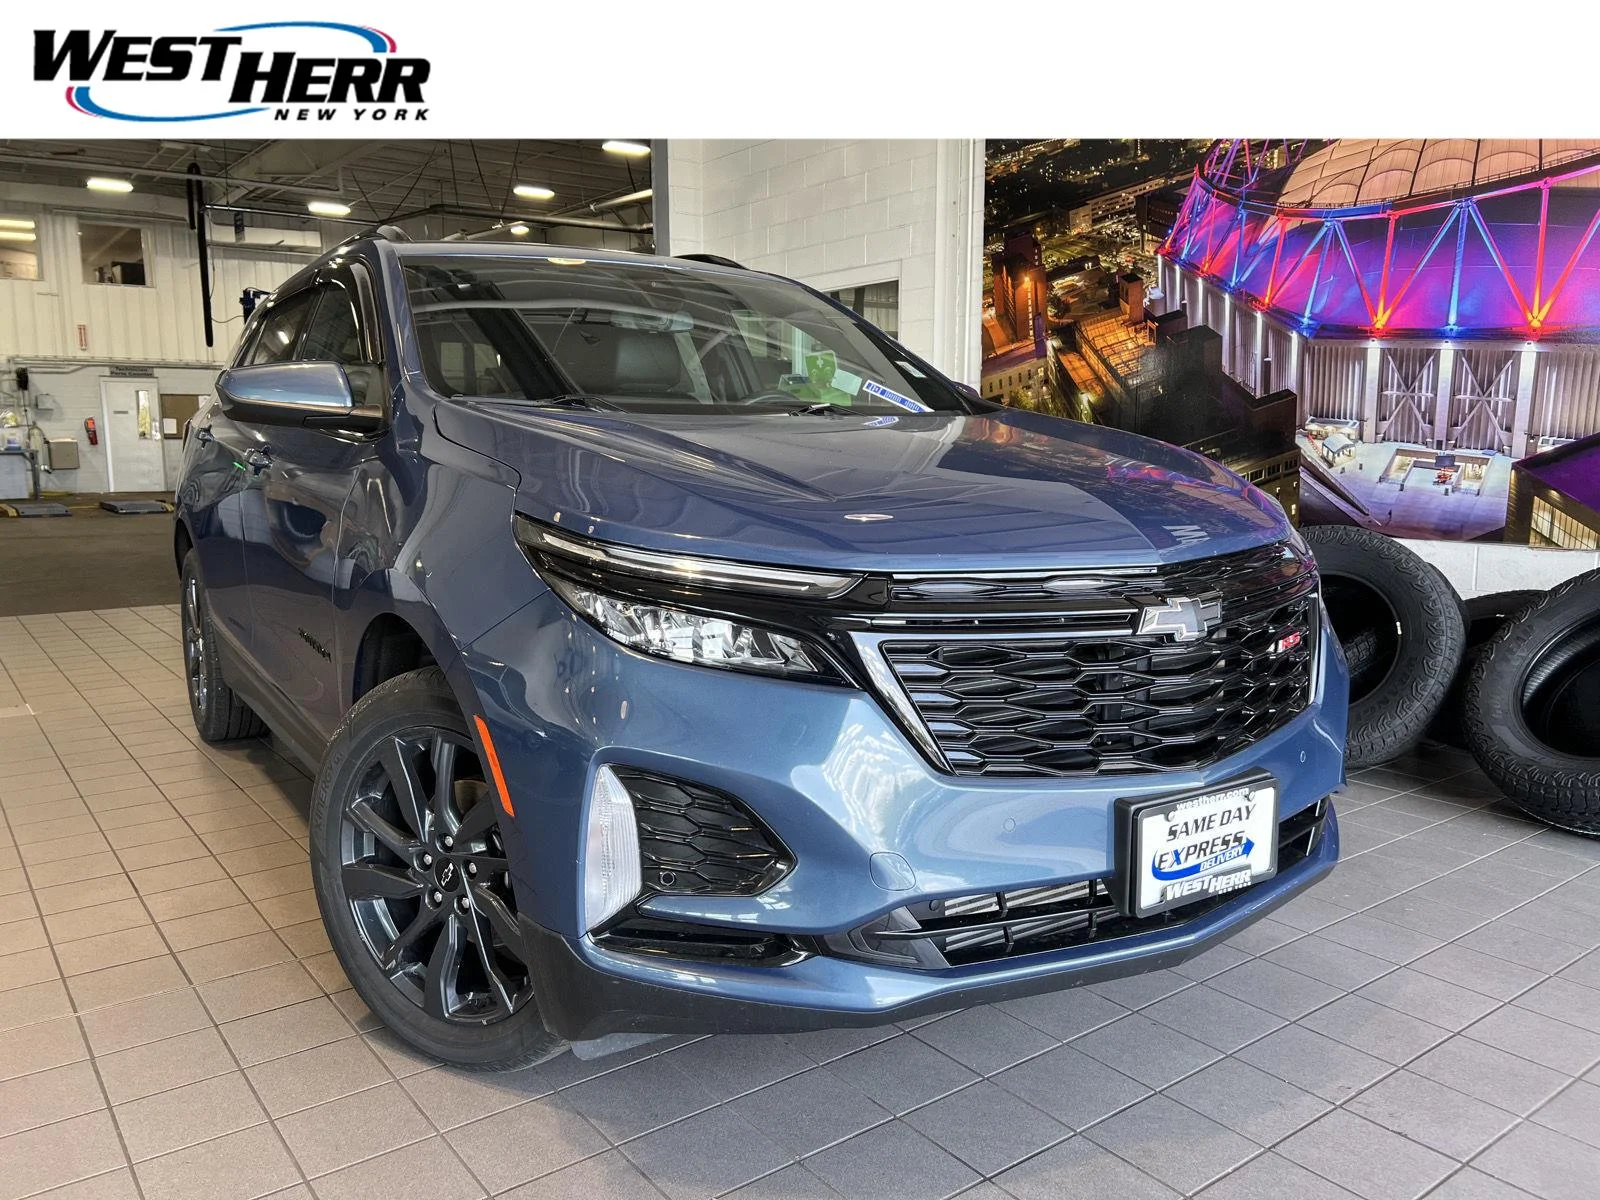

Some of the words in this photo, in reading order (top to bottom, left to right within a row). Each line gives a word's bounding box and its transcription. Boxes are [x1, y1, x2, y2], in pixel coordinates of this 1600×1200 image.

[1166, 813, 1217, 842] SAME
[1220, 804, 1256, 826] DAY
[1157, 830, 1245, 870] EXPRESS
[1200, 845, 1246, 871] DELIVERY
